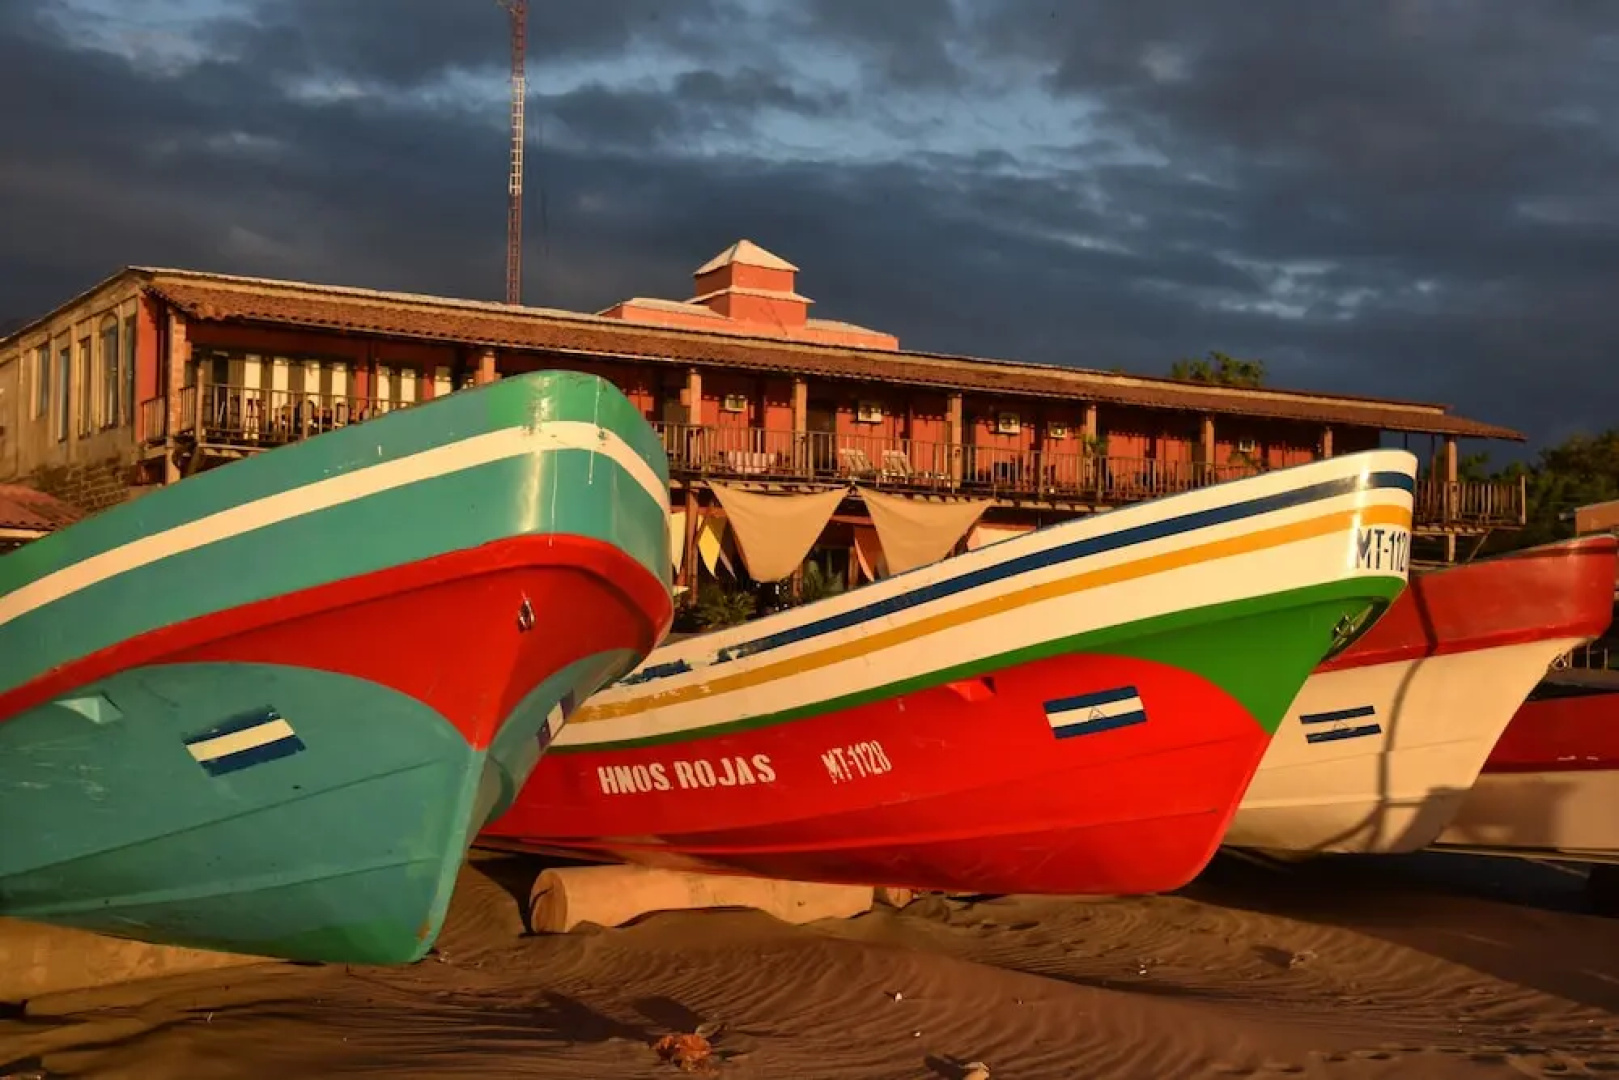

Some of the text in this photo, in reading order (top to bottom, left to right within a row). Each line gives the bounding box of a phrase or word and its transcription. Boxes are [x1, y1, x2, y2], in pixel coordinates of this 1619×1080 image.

[1356, 527, 1409, 572] MT-112
[673, 754, 776, 789] ROJAS
[821, 740, 892, 784] MT-1128
